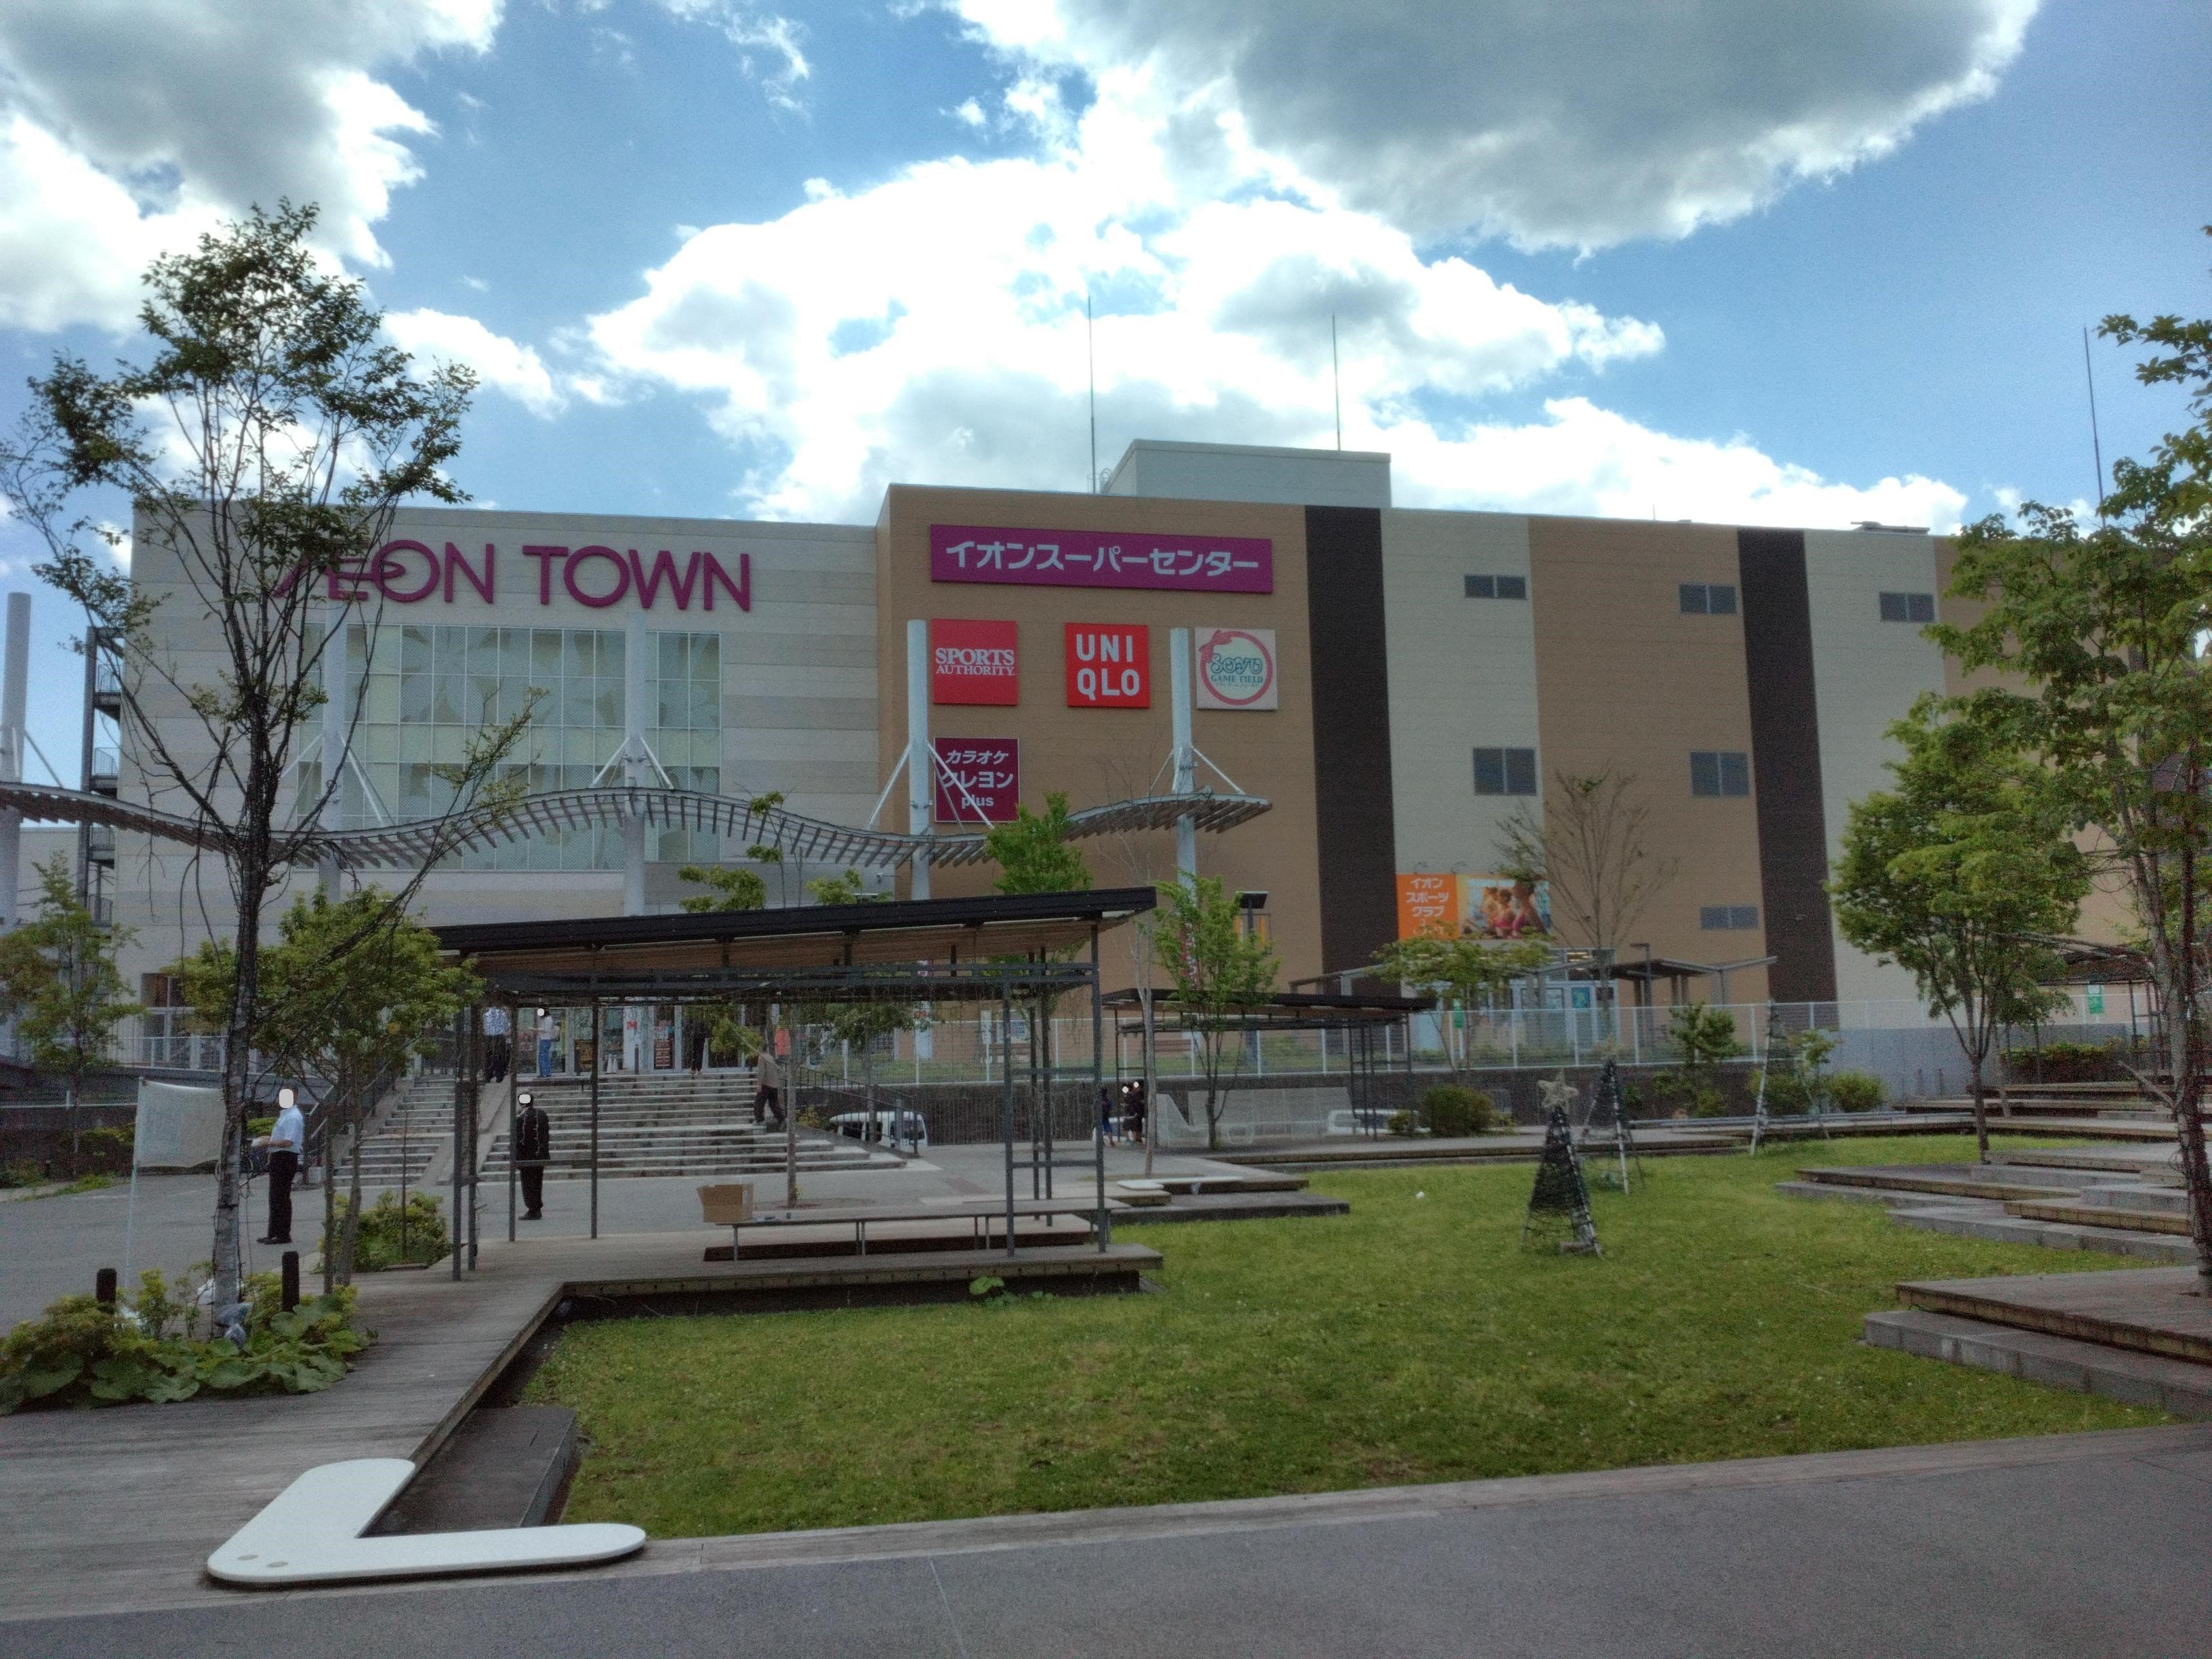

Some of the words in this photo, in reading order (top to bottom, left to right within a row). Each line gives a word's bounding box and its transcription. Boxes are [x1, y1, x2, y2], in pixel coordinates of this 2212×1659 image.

[945, 540, 1260, 577] イオンスーパーセンター
[521, 545, 751, 612] TOWN
[935, 647, 1015, 666] SPORTS
[1076, 634, 1133, 663] UNI
[935, 664, 1015, 676] AUTHORITY
[1210, 674, 1237, 682] GAME
[1239, 676, 1263, 684] FIELD
[1077, 668, 1140, 701] QLO
[945, 750, 1009, 765] カラオケ
[940, 770, 1014, 789] クレヨン
[961, 794, 995, 809] plus
